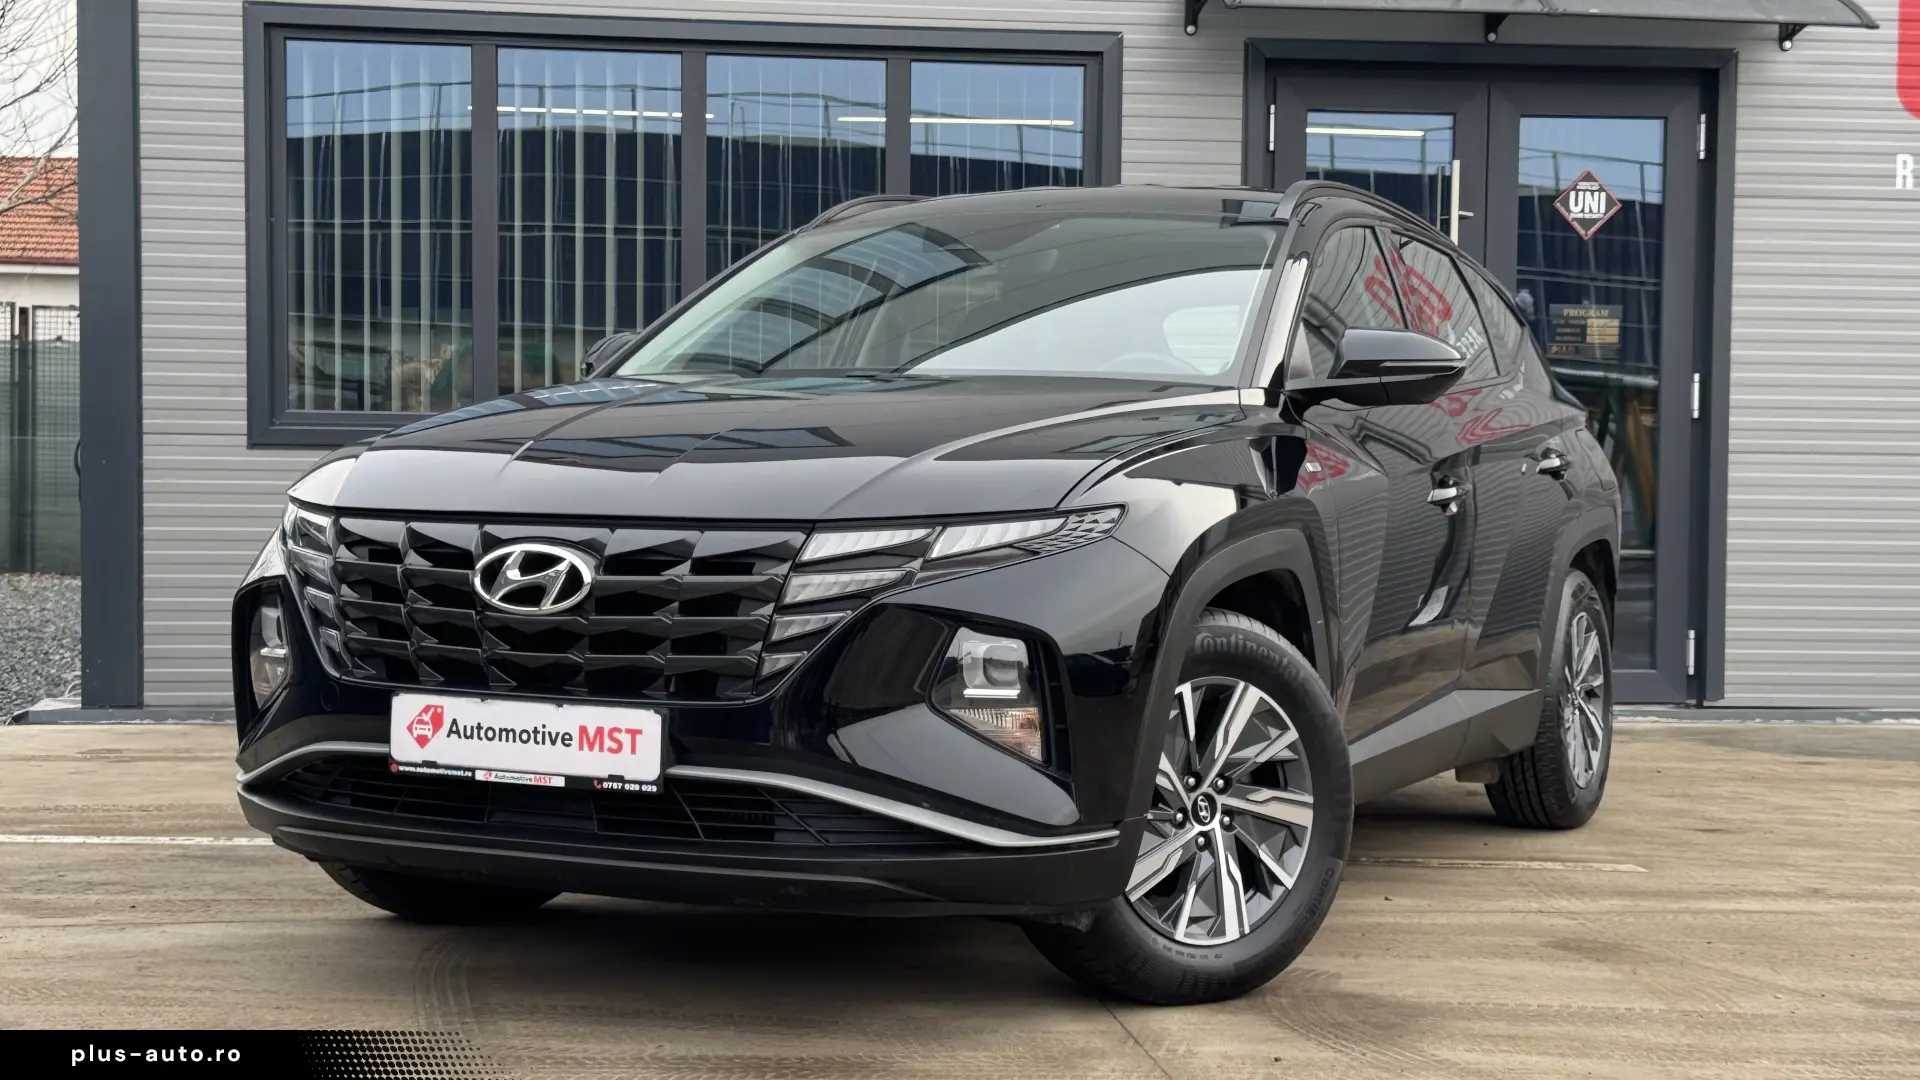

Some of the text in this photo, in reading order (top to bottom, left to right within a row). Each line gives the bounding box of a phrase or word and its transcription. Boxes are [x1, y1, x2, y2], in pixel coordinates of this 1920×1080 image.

[1895, 153, 1914, 190] R
[1569, 190, 1607, 214] UNI
[446, 718, 643, 755] Automotive MST
[533, 775, 552, 785] MST
